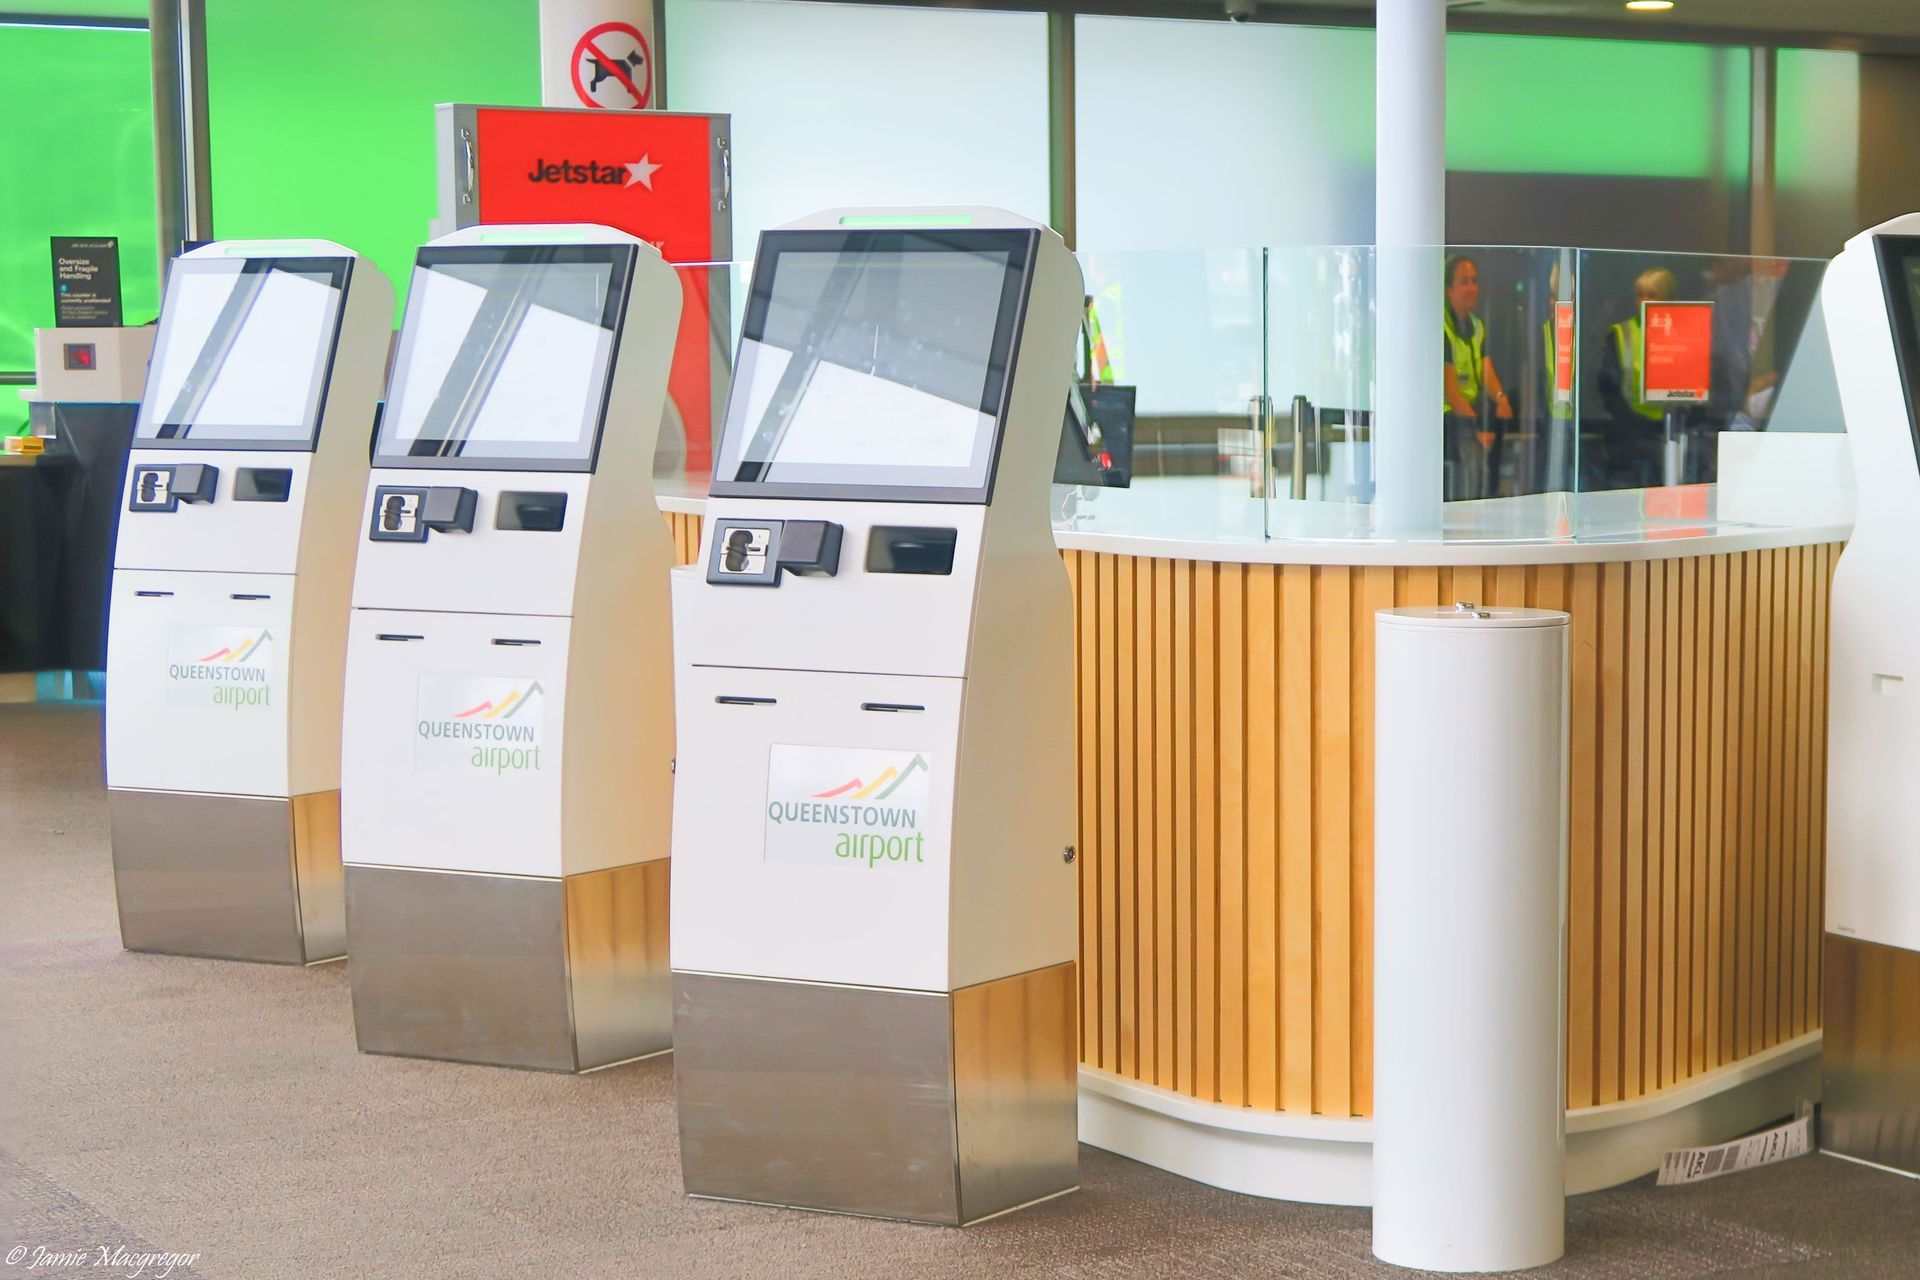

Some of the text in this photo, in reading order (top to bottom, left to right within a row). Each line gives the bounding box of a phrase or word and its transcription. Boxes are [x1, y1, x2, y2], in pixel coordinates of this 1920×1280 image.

[528, 158, 627, 185] Jetstar
[74, 265, 98, 273] Fragile
[169, 664, 265, 682] QUEENSTOWN
[213, 684, 271, 711] airport
[418, 720, 535, 742] QUEENSTOWN
[471, 745, 541, 776] airport
[768, 801, 916, 828] QUEENSTOWN
[835, 832, 924, 868] airport
